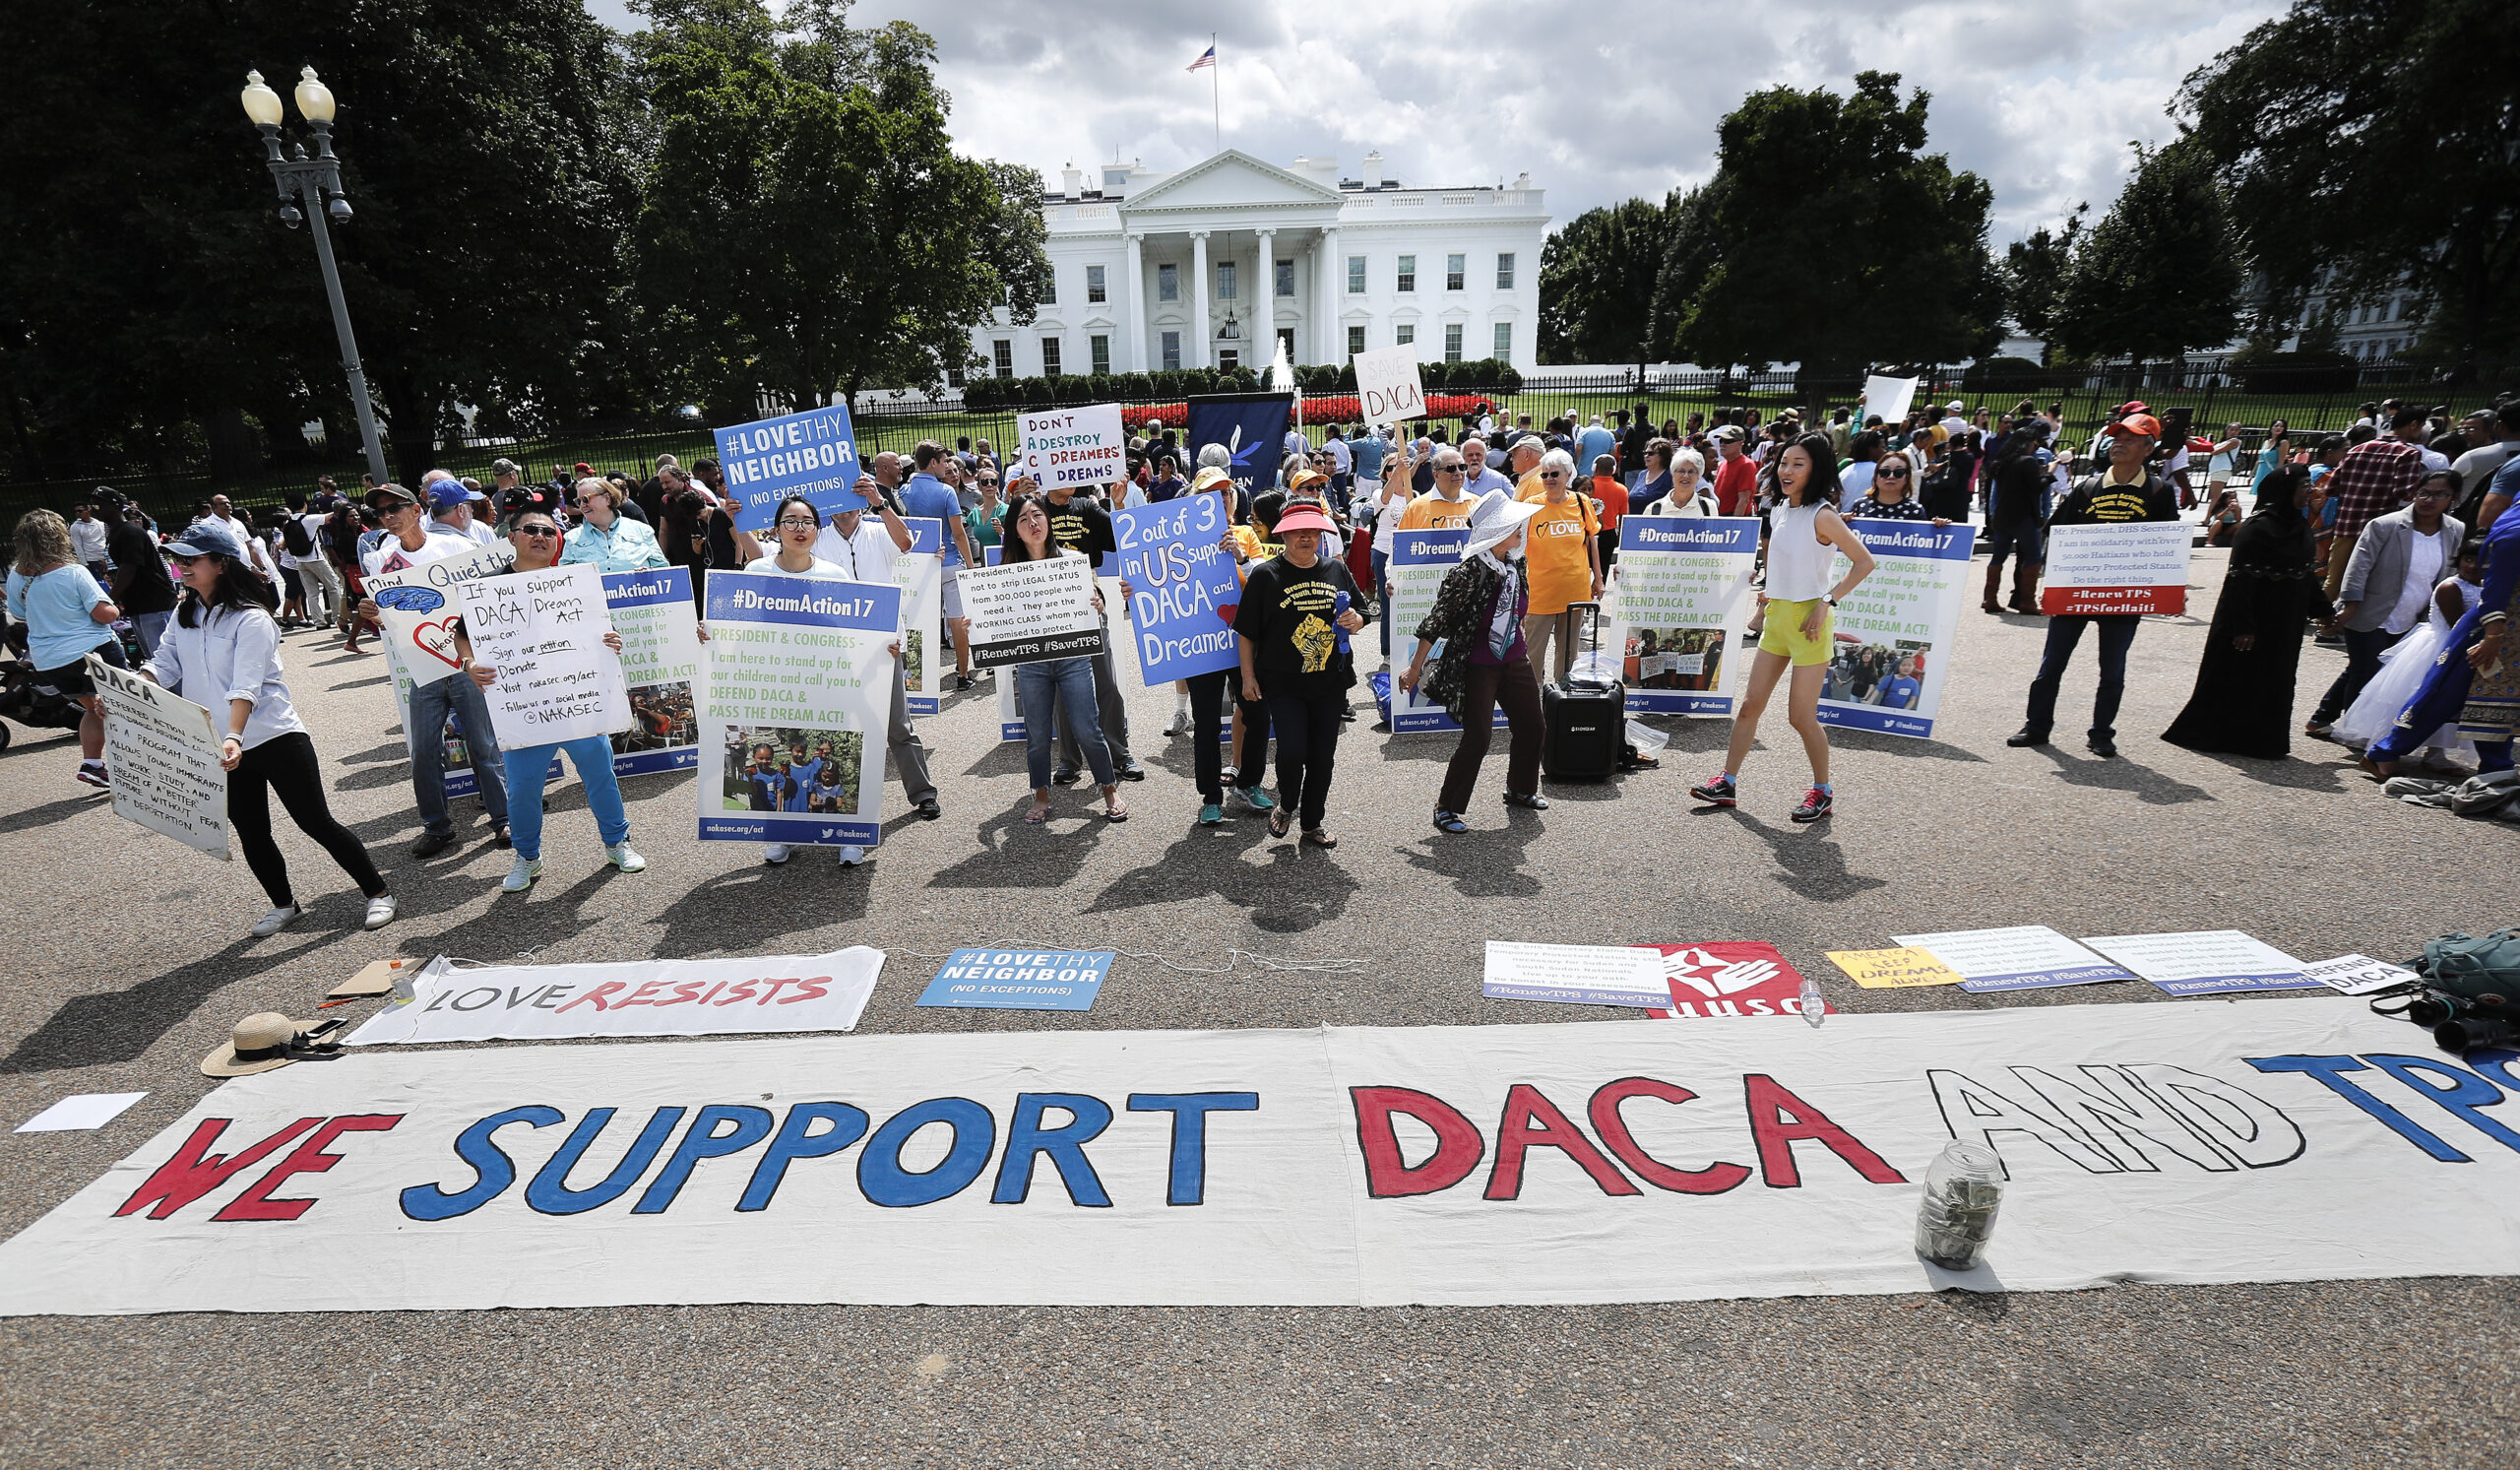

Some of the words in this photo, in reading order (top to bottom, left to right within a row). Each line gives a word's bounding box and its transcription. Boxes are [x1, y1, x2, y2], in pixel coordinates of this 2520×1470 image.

[1368, 356, 1405, 380] SAVE
[1367, 383, 1420, 416] DACA
[1029, 415, 1074, 431] DON'T
[726, 414, 841, 457] #LOVETHY
[1028, 437, 1037, 450] A
[1040, 433, 1101, 450] DESTROY
[728, 441, 852, 485] NEIGHBOR
[1029, 455, 1038, 467] C
[1050, 445, 1119, 465] DREAMERS'
[1057, 465, 1112, 481] DREAMS
[750, 491, 770, 507] (NO
[774, 477, 845, 500] EXCEPTIONS)
[1116, 513, 1138, 550] 2
[1142, 516, 1169, 543] out
[1172, 507, 1187, 536] of
[1196, 495, 1216, 532] 3
[1549, 523, 1582, 536] LOVE
[1638, 528, 1741, 544] #DreamAction17
[1852, 529, 1954, 550] DreamAction17
[2091, 538, 2134, 547] solidarity
[428, 558, 484, 587] Quiet
[486, 552, 515, 570] the
[974, 568, 1015, 579] President,
[1017, 564, 1034, 573] DHS
[1050, 561, 1069, 571] urge
[1072, 558, 1087, 569] you
[1125, 558, 1141, 576] in
[1142, 542, 1191, 588] US
[1188, 542, 1231, 566] suppo
[1623, 555, 1669, 566] PRESIDENT
[1680, 557, 1725, 567] CONGRESS
[1884, 561, 1934, 574] CONGRESS
[2053, 564, 2101, 573] Temporary
[368, 576, 403, 592] Mind
[1001, 580, 1020, 590] strip
[1023, 576, 1045, 585] LEGAL
[1049, 571, 1079, 581] STATUS
[1398, 569, 1440, 581] PRESIDENT
[2105, 576, 2125, 585] right
[463, 583, 486, 600] If
[494, 586, 515, 602] you
[528, 575, 573, 593] support
[606, 579, 672, 600] mAction17
[993, 591, 1030, 602] 300,000
[1034, 589, 1062, 598] people
[2072, 589, 2152, 599] #RenewTPS
[733, 590, 874, 617] #DreamAction17
[1022, 603, 1041, 611] They
[1135, 579, 1214, 629] DACA
[1213, 577, 1233, 595] and
[1618, 596, 1654, 607] DEFEND
[1658, 597, 1682, 608] DACA
[1858, 603, 1885, 615] DACA
[2066, 604, 2155, 612] #TPSforHaiti
[619, 607, 665, 621] CONGRESS
[976, 617, 1014, 629] WORKING
[1017, 615, 1040, 624] CLASS
[1045, 611, 1070, 620] whom
[1074, 609, 1088, 619] you
[1616, 610, 1640, 621] PASS
[1664, 611, 1698, 623] DREAM
[1701, 612, 1723, 624] ACT!
[991, 630, 1028, 641] promised
[1043, 623, 1075, 635] protect.
[1863, 619, 1901, 632] DREAM
[1905, 622, 1929, 635] ACT!
[474, 634, 491, 648] you
[500, 630, 520, 639] can:
[712, 628, 777, 644] PRESIDENT
[794, 632, 855, 648] CONGRESS
[522, 646, 535, 655] our
[540, 640, 571, 652] petition
[975, 644, 1040, 661] #RenewTPS
[1044, 636, 1100, 652] #SaveTPS
[740, 652, 765, 664] here
[785, 655, 816, 668] stand
[837, 657, 851, 670] for
[498, 662, 537, 679] Donate
[628, 667, 668, 683] DREAM
[673, 664, 697, 676] ACT!
[733, 669, 777, 683] children
[804, 673, 822, 685] call
[827, 676, 846, 689] you
[92, 660, 158, 706] DACA
[530, 671, 598, 689] nakasec.org/act
[556, 691, 574, 704] social
[578, 690, 599, 701] media
[710, 686, 756, 700] DEFEND
[761, 689, 793, 702] DACA
[709, 705, 739, 718] PASS
[745, 706, 767, 720] THE
[771, 707, 813, 722] DREAM
[818, 710, 845, 723] ACT!
[154, 718, 185, 736] ACTION
[137, 735, 181, 760] PROGRAM
[185, 754, 207, 770] THAT
[110, 739, 142, 759] ALLOWS
[147, 753, 172, 771] YOUNG
[176, 767, 224, 792] IMMIGRANTS
[113, 765, 140, 784] DREAM
[115, 778, 144, 797] FUTURE
[151, 795, 191, 817] WITHOUT
[200, 815, 220, 830] FEAR
[706, 824, 764, 835] nakasec.org/act
[837, 830, 870, 839] @nakasec
[958, 952, 1103, 968] #LOVETHY
[1841, 949, 1919, 961] AMERICA
[1871, 957, 1911, 969] KEEP
[942, 966, 1100, 983] NEIGHBOR
[1860, 964, 1949, 979] DREAMS
[2301, 958, 2376, 976] DEFEND
[2326, 968, 2406, 988] DACA
[949, 985, 976, 993] (NO
[981, 986, 1073, 996] EXCEPTIONS)
[111, 1113, 406, 1222] WE
[398, 1092, 1262, 1222] SUPPORT
[1347, 1073, 1911, 1203] DACA
[1925, 1062, 2308, 1183] AND
